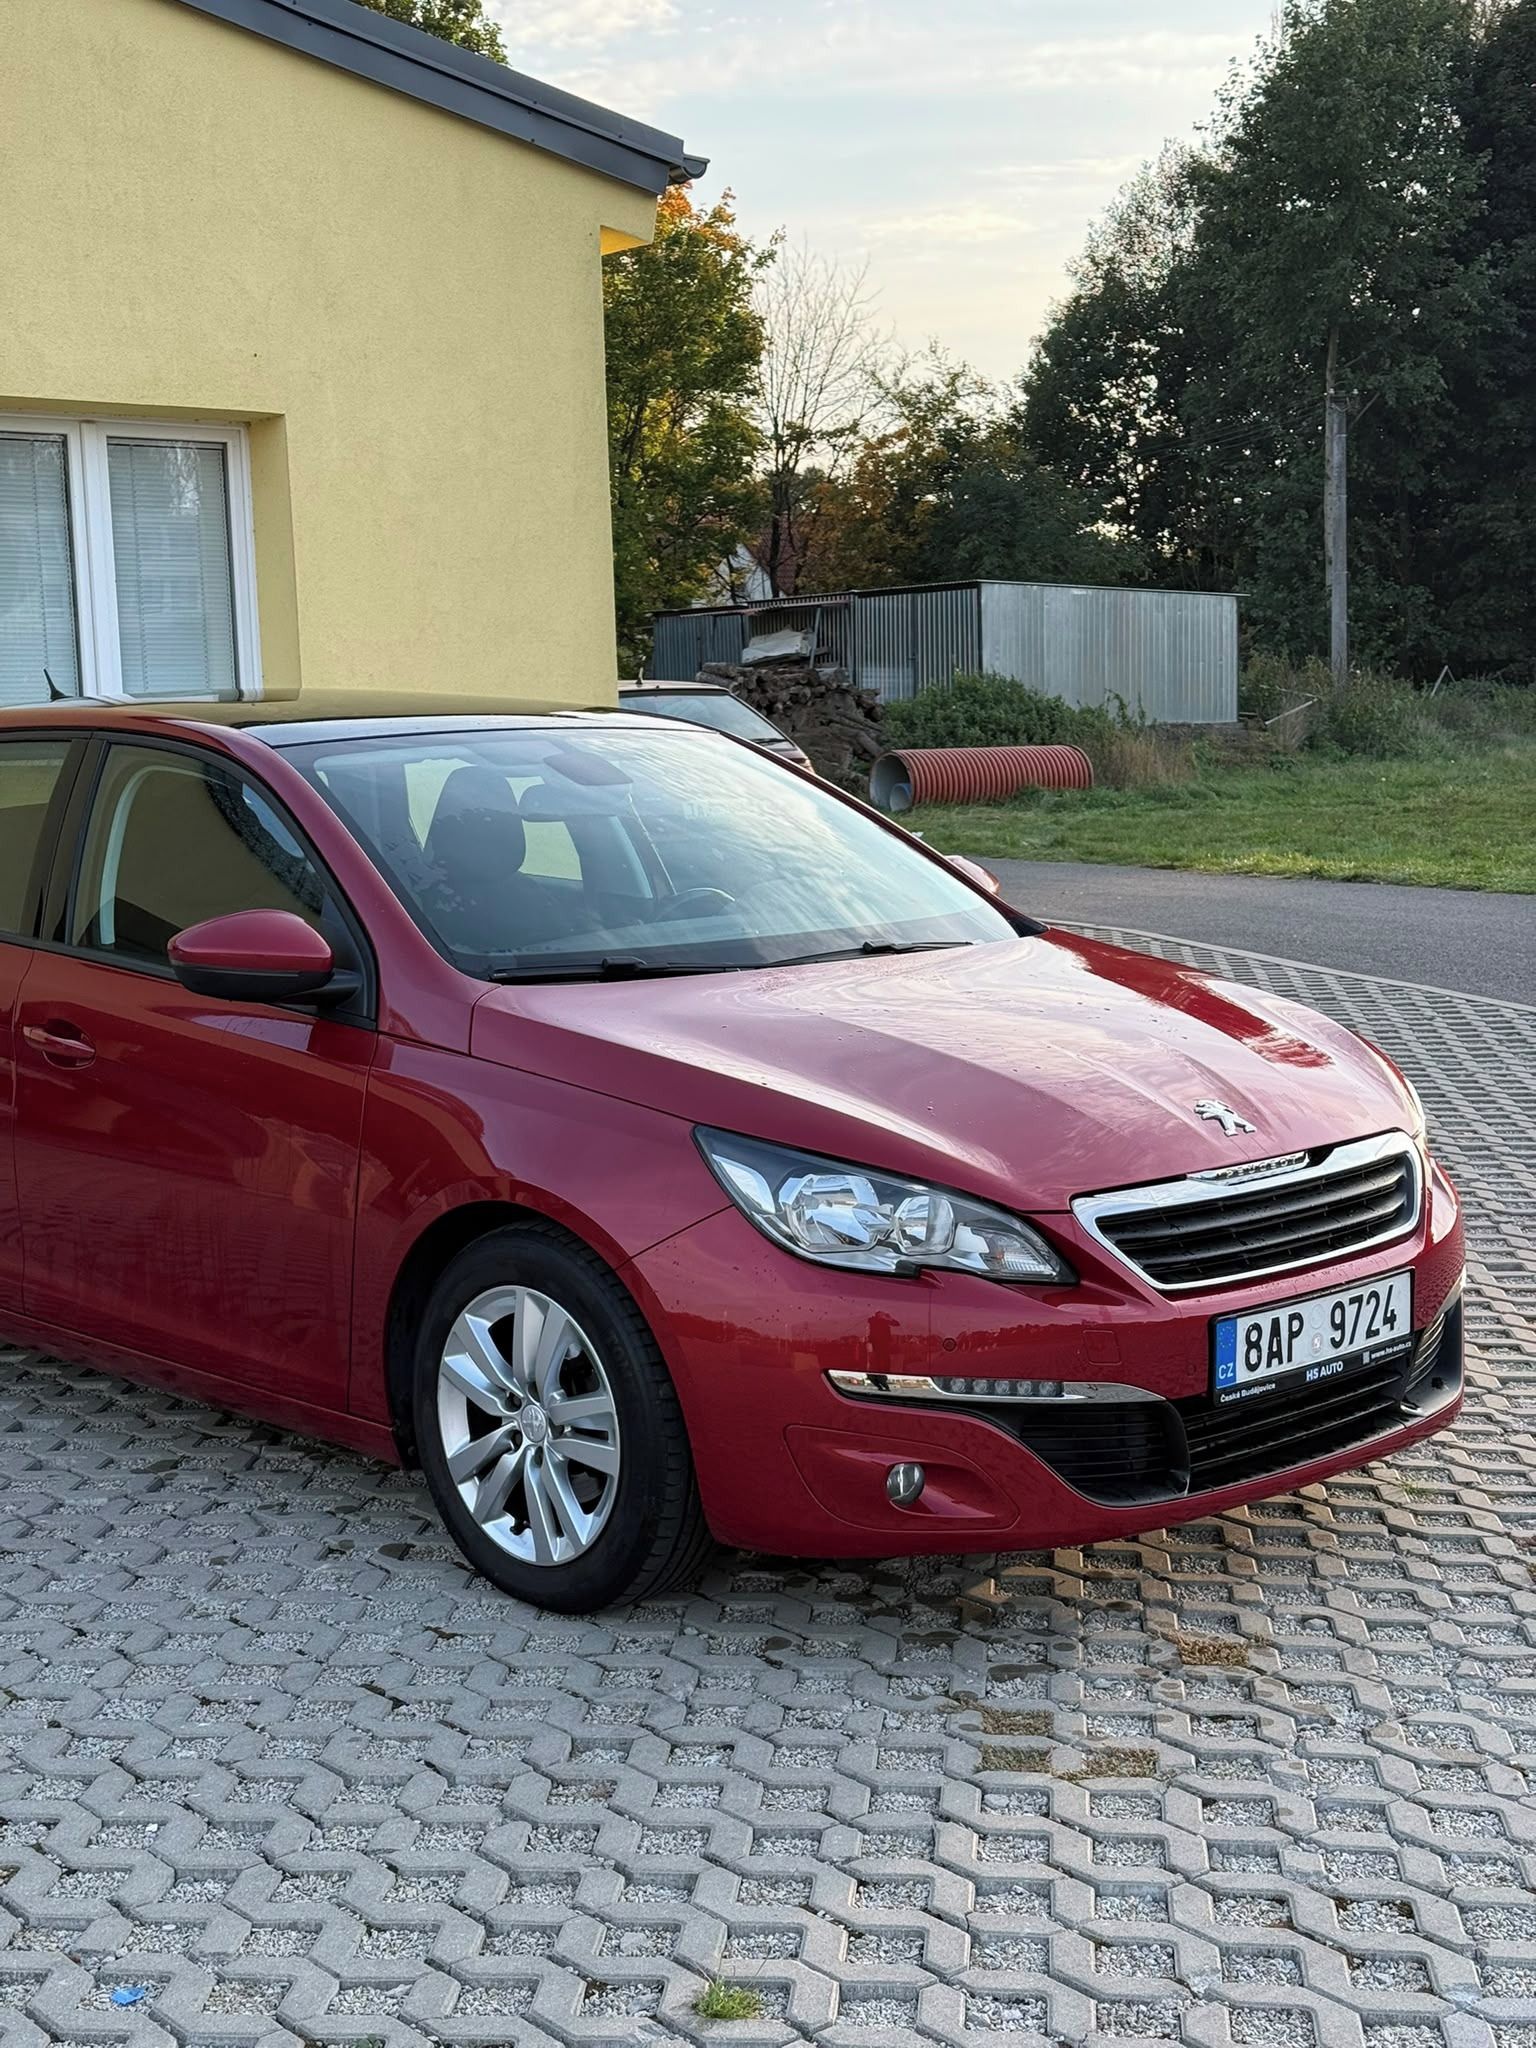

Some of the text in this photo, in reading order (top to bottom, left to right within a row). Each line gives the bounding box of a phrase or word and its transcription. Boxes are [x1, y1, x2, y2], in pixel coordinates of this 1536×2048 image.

[1245, 1284, 1397, 1372] 8AP 9724
[1218, 1362, 1234, 1379] CZ
[1306, 1361, 1344, 1381] HS AUTO
